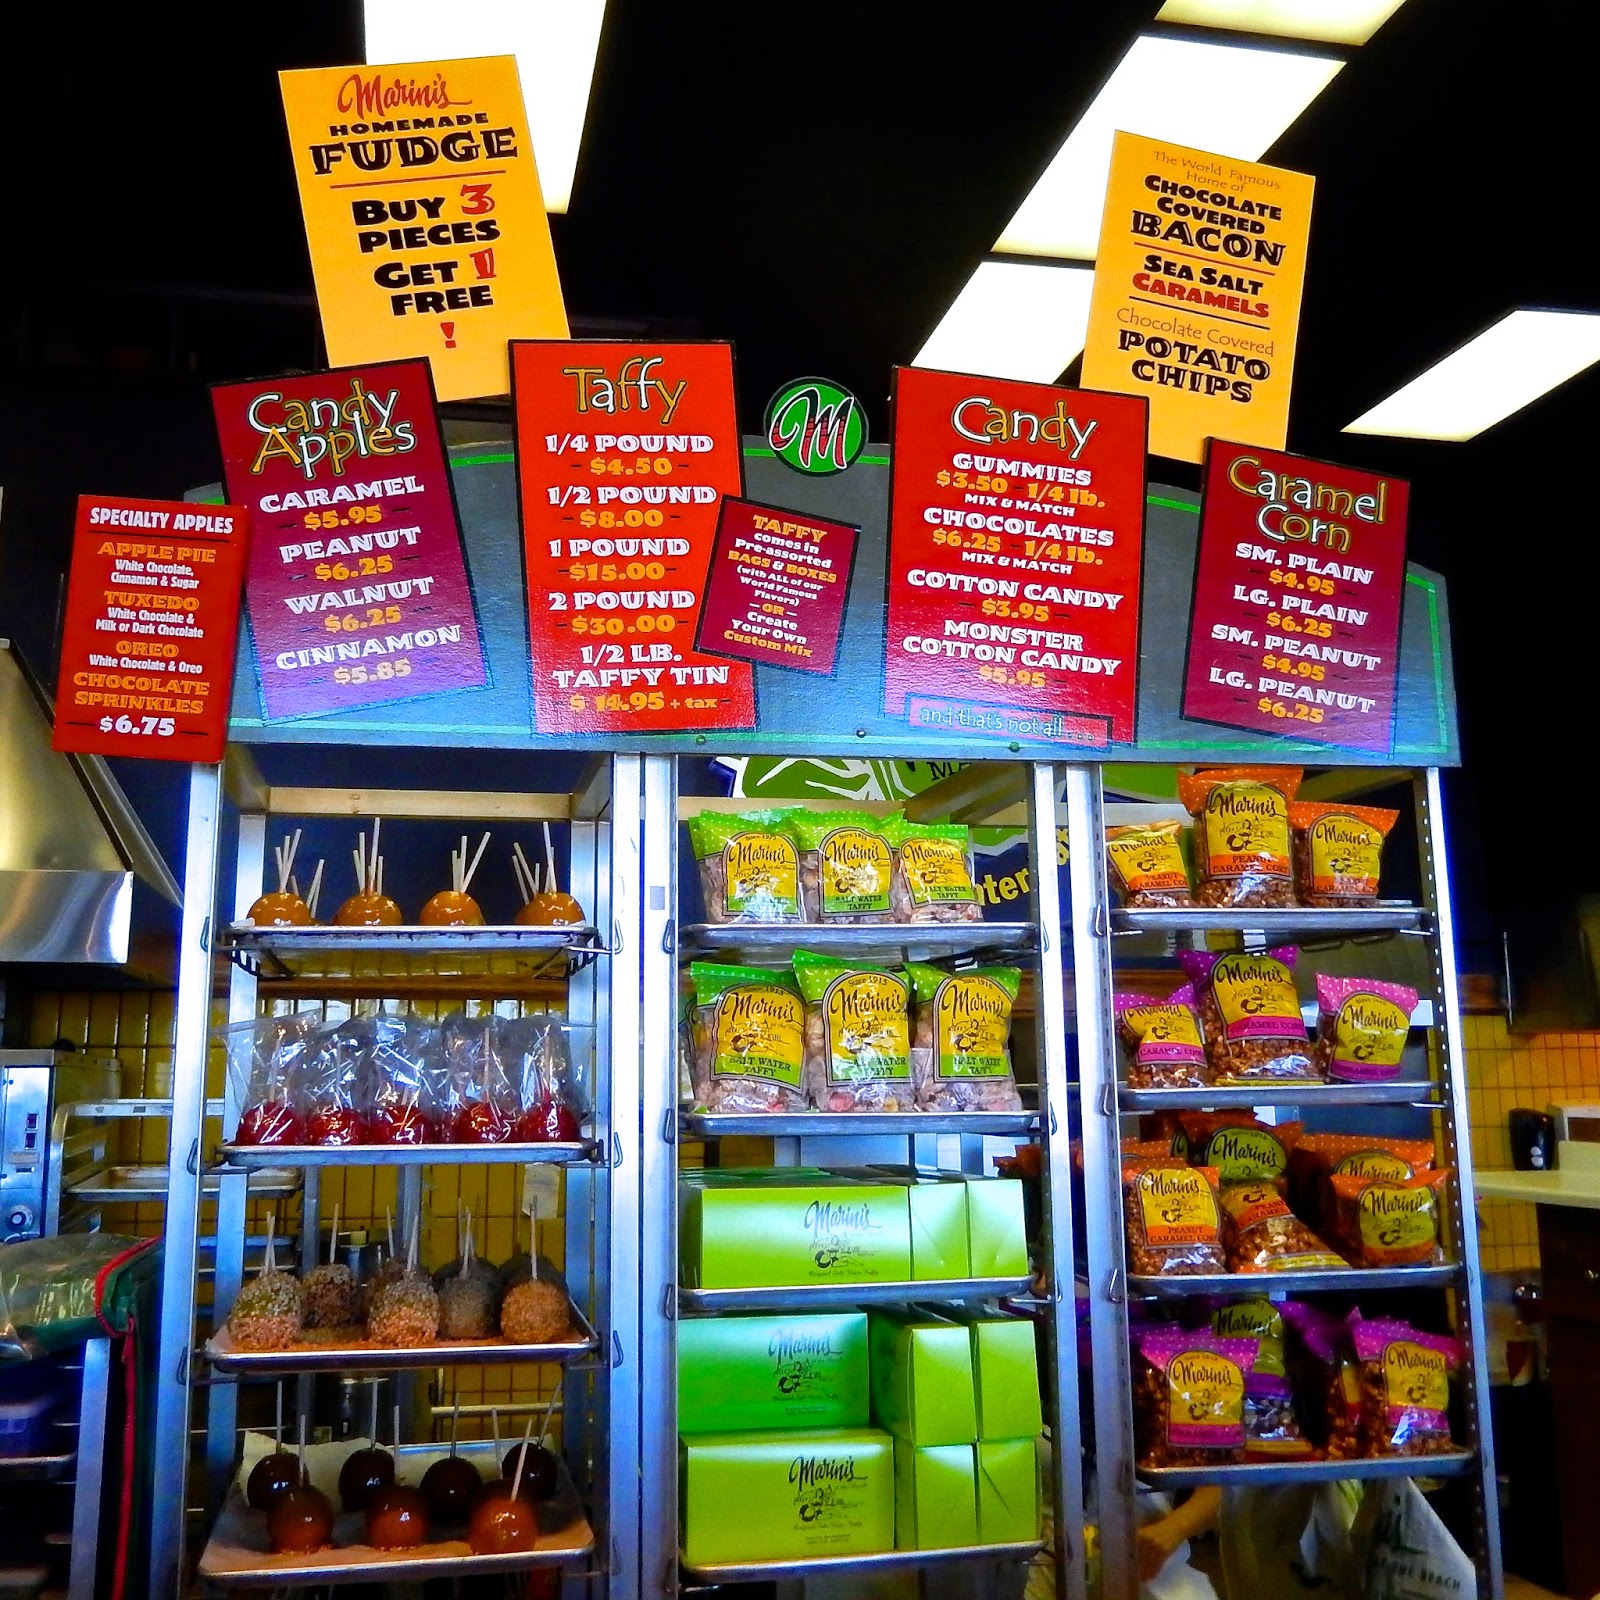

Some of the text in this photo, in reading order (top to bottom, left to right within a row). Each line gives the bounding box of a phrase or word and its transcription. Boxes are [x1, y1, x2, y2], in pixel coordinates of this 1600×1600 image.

[337, 73, 472, 120] Marini's
[330, 112, 489, 136] HOMEMADE
[309, 126, 518, 175] FUDGE
[1154, 151, 1280, 190] The World Famous
[1186, 171, 1247, 193] Home of
[351, 184, 496, 226] BUY 3
[1144, 174, 1282, 221] CHOCOLATE
[1157, 196, 1266, 235] COVERED
[358, 220, 500, 254] PIECES
[1131, 210, 1286, 266] BACON
[374, 248, 496, 289] GET 1
[1144, 254, 1263, 295] SEA SALT
[390, 286, 494, 316] FREE
[1132, 273, 1269, 318] CARAMELS
[1117, 307, 1274, 357] Chocolate Covered
[1118, 329, 1270, 381] POTATO
[562, 357, 687, 425] Taffy
[1131, 359, 1253, 403] CHIPS
[249, 378, 399, 434] Candy
[769, 387, 854, 469] M
[952, 396, 1098, 460] Candy
[251, 411, 416, 479] Apples
[544, 434, 714, 455] 1/4 POUND
[590, 457, 673, 476] $4.50
[952, 453, 1092, 486] GUMMIES
[259, 475, 425, 513] CARAMEL
[547, 485, 717, 506] 1/2 POUND
[936, 469, 1106, 509] $3.50 1/4 lb.
[1227, 455, 1386, 523] Caramel
[303, 505, 383, 531] $5.95
[579, 509, 664, 528] $8.00
[964, 493, 1075, 518] MIX & MATCH
[90, 507, 233, 534] SPECIALTY APPLES
[753, 514, 827, 543] TAFFY
[923, 506, 1115, 547] CHOCOLATES
[1256, 503, 1350, 553] Corn
[98, 542, 216, 563] APPLE PIE
[280, 526, 421, 564] PEANUT
[548, 538, 690, 557] 1 POUND
[735, 538, 832, 569] Pre-assorted
[754, 533, 819, 555] comes in
[932, 528, 1104, 566] $6.25 1/4 lb.
[115, 560, 194, 576] White Chocolate,
[314, 555, 394, 582] $6.25
[569, 562, 665, 581] $15.00
[728, 550, 837, 584] BAGS & BOXES
[962, 551, 1073, 575] MIX & MATCH
[1235, 542, 1374, 585] SM. PLAIN
[111, 572, 199, 590] Cinnamon & Sugar
[737, 565, 823, 591] (with ALL of our
[740, 576, 817, 600] World Famous
[907, 569, 1124, 611] COTTON CANDY
[1268, 569, 1334, 596] $4.95
[104, 591, 199, 611] TUXEDO
[285, 576, 435, 615] WALNUT
[548, 591, 695, 611] 2 POUND
[754, 590, 800, 607] Flavors)
[1233, 584, 1368, 626] LG. PLAIN
[108, 608, 195, 624] White Chocolate &
[324, 604, 402, 633] $6.25
[747, 611, 798, 631] Create
[762, 603, 785, 616] OR
[981, 598, 1050, 622] $3.95
[96, 619, 204, 638] Milk or Dark Chocolate
[571, 614, 676, 634] $30.00
[732, 619, 807, 645] Your Own
[944, 619, 1084, 652] MONSTER
[1266, 611, 1332, 638] $6.25
[115, 640, 179, 658] OREO
[276, 625, 461, 670] CINNAMON
[580, 644, 683, 665] 1/2 LB.
[724, 630, 813, 657] Custom Mix
[902, 635, 1122, 676] COTTON CANDY
[1211, 624, 1381, 672] SM. PEANUT
[89, 655, 202, 674] White Chocolate & Oreo
[333, 658, 412, 685] $5.85
[552, 666, 730, 689] TAFFY TIN
[979, 665, 1047, 688] $5.95
[1262, 654, 1325, 682] $4.95
[73, 672, 210, 696] CHOCOLATE
[1209, 667, 1376, 714] LG. PEANUT
[74, 691, 203, 714] SPRINKLES
[670, 699, 680, 709] +
[684, 697, 717, 708] tax
[1258, 697, 1324, 724] $6.25
[100, 714, 176, 736] $6.75
[920, 707, 952, 726] and
[957, 706, 1002, 730] that's
[1008, 719, 1039, 734] not
[745, 1066, 776, 1076] TAFFY
[758, 1058, 790, 1072] WATER
